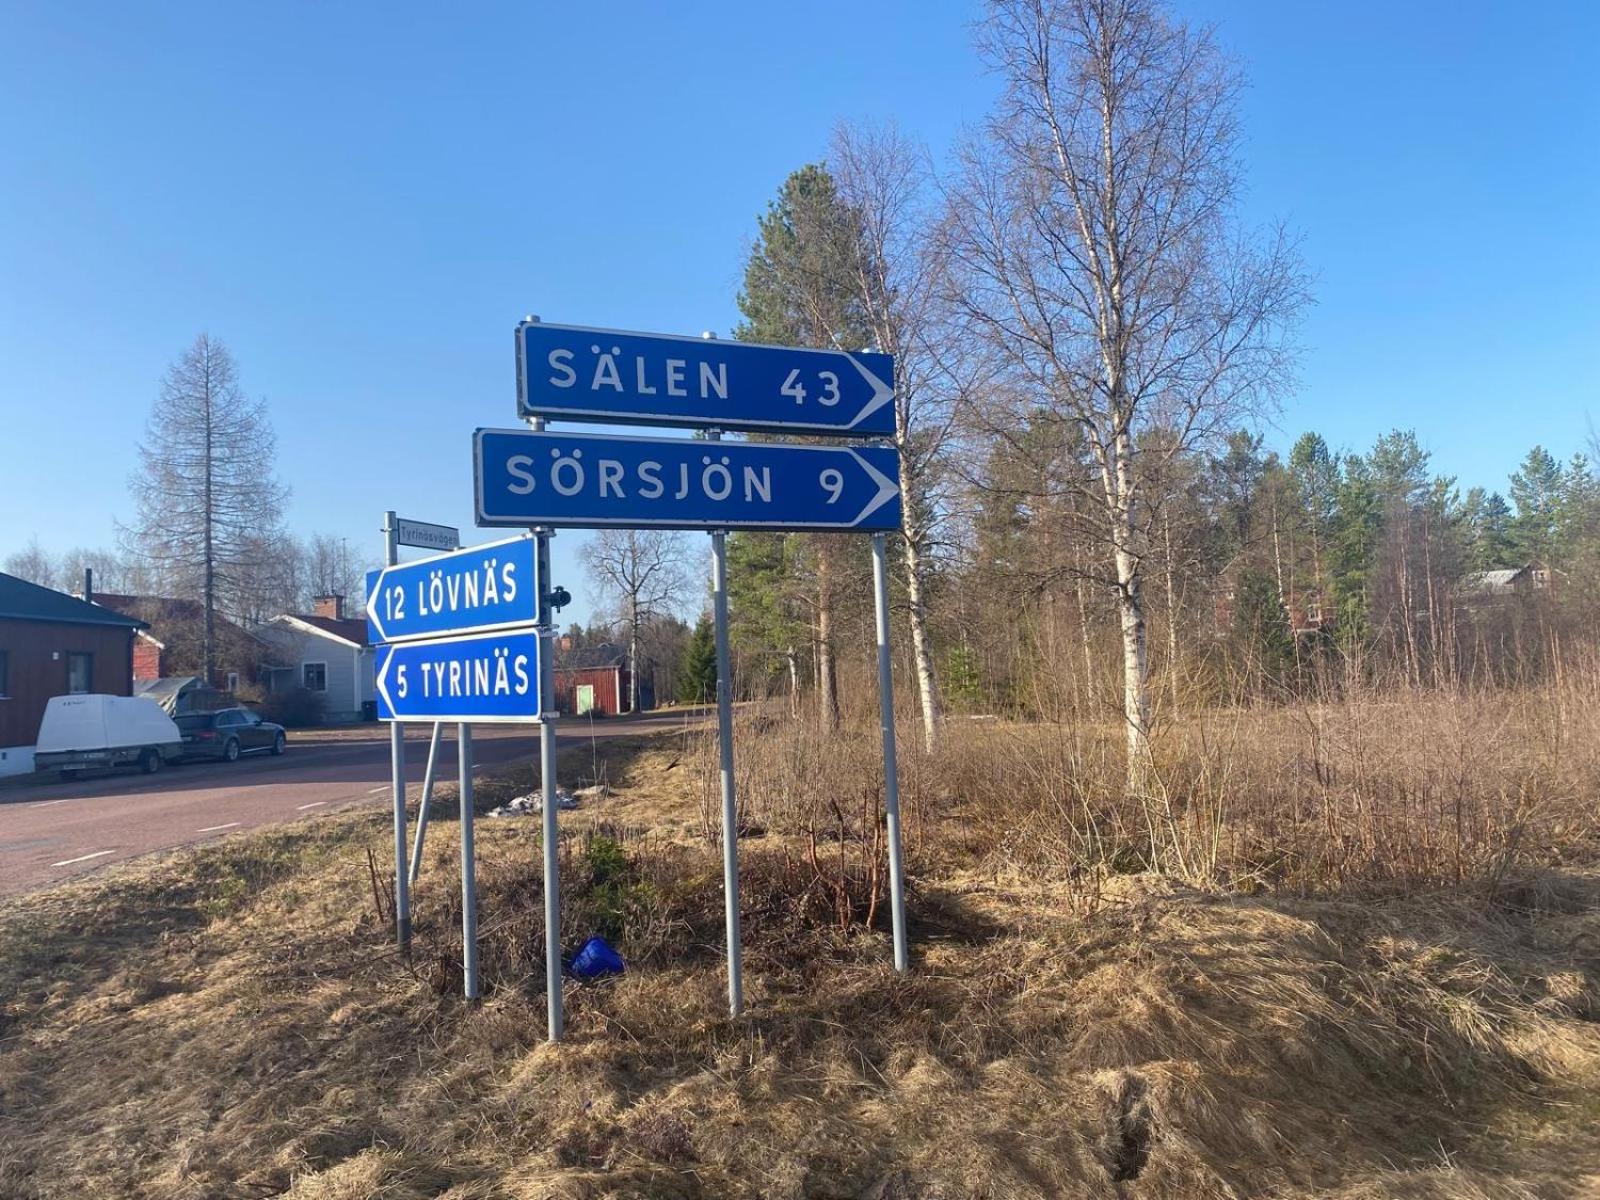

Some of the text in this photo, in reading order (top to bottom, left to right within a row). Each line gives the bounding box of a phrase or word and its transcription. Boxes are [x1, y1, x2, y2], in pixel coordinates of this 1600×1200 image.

[548, 344, 841, 407] SÄLEN 43
[507, 447, 844, 504] SÖRSJÖN 9
[385, 558, 517, 621] 12 LÖVNÄS
[397, 647, 529, 698] 5 TYRINÄS
